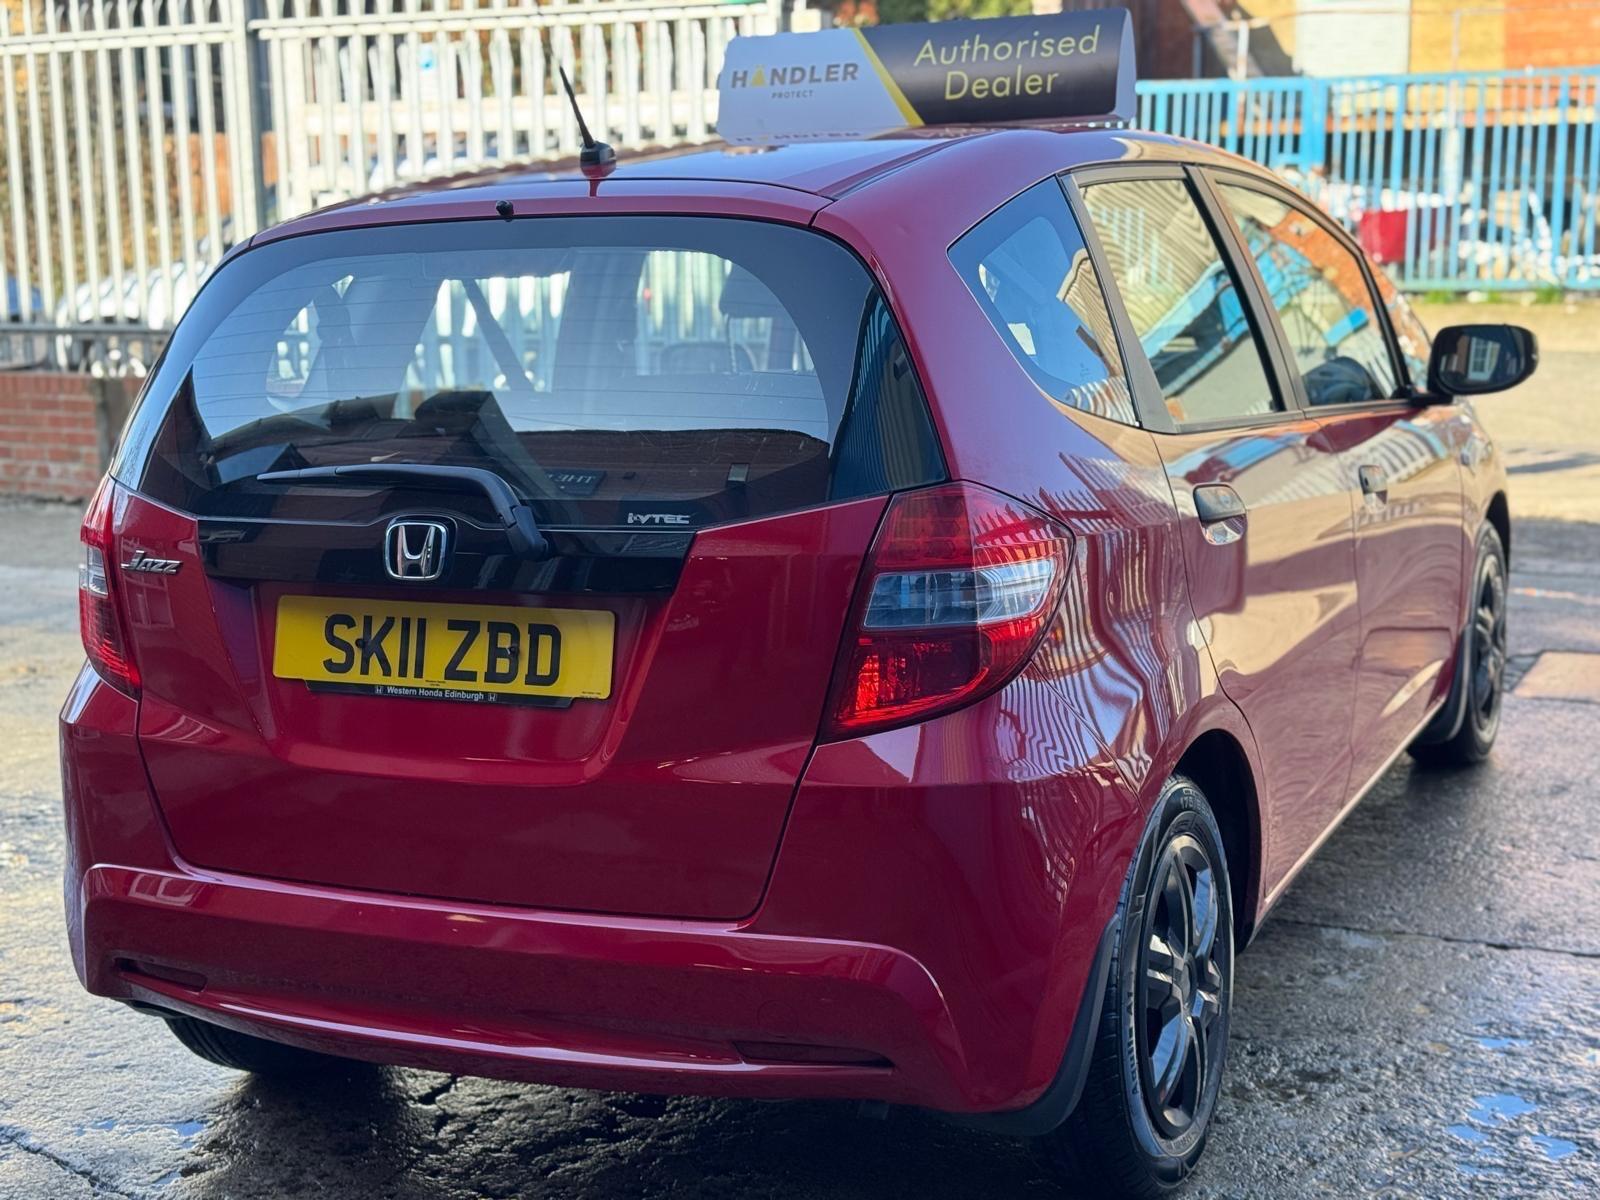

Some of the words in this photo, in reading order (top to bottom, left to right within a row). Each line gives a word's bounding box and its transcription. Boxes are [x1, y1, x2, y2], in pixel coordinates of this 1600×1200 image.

[913, 24, 1101, 67] Authorised
[771, 89, 814, 99] PROTECT
[945, 64, 1059, 101] Dealer
[121, 549, 182, 574] Jazz
[443, 618, 562, 687] ZBD
[386, 686, 417, 696] Western
[418, 687, 443, 698] Honda
[444, 690, 485, 701] Edinburgh
